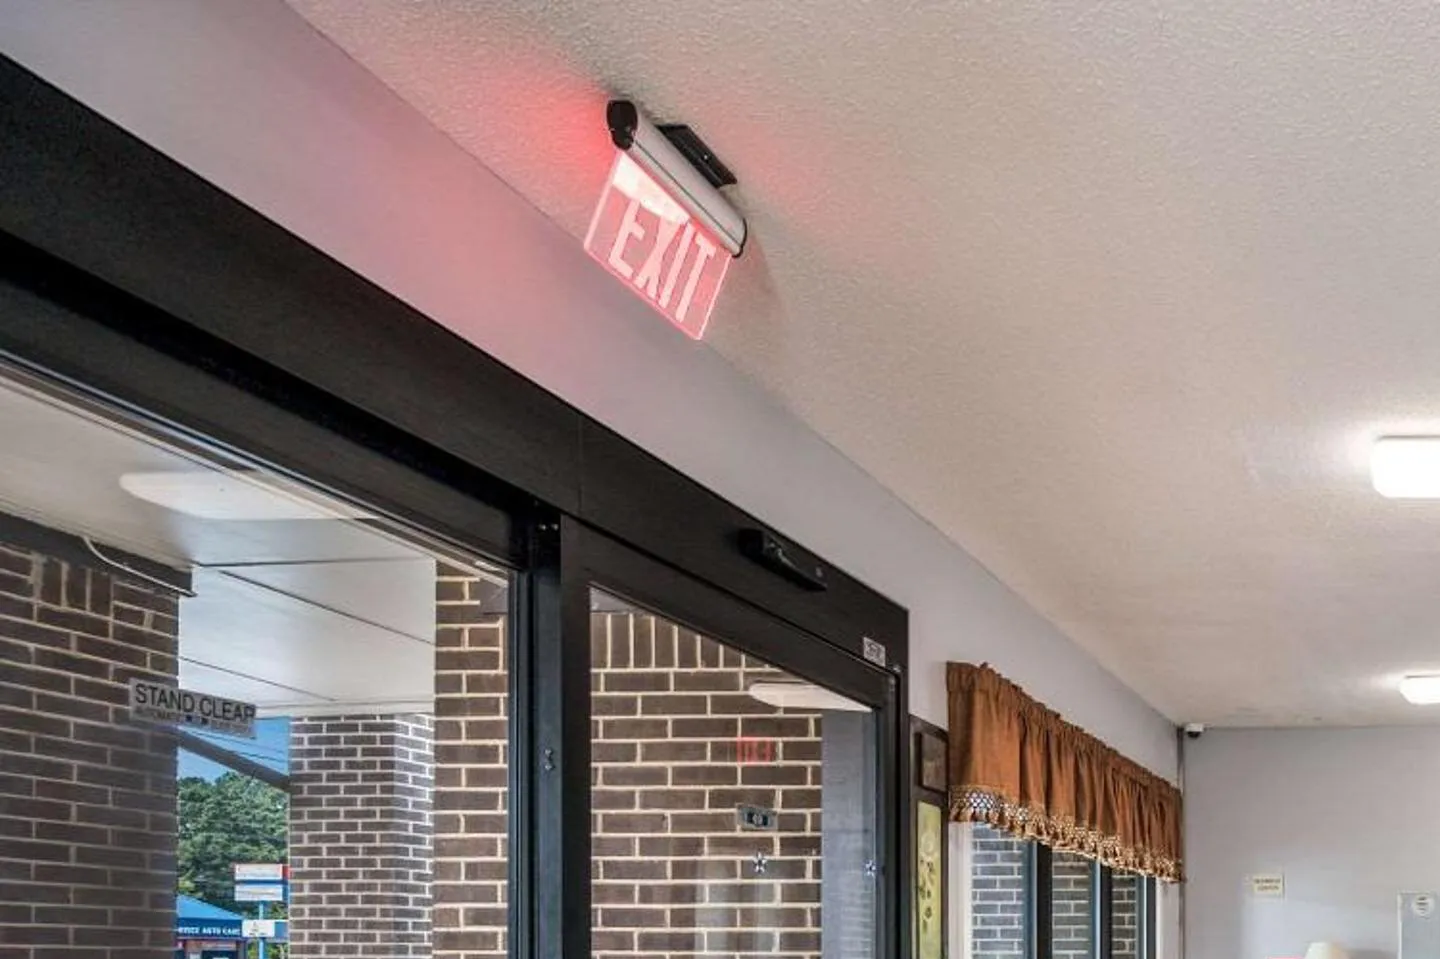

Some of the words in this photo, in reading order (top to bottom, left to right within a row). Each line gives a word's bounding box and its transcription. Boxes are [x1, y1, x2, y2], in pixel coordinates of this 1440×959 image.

[608, 200, 716, 323] EXIT
[135, 683, 195, 712] STAND
[200, 697, 256, 721] CLEAR
